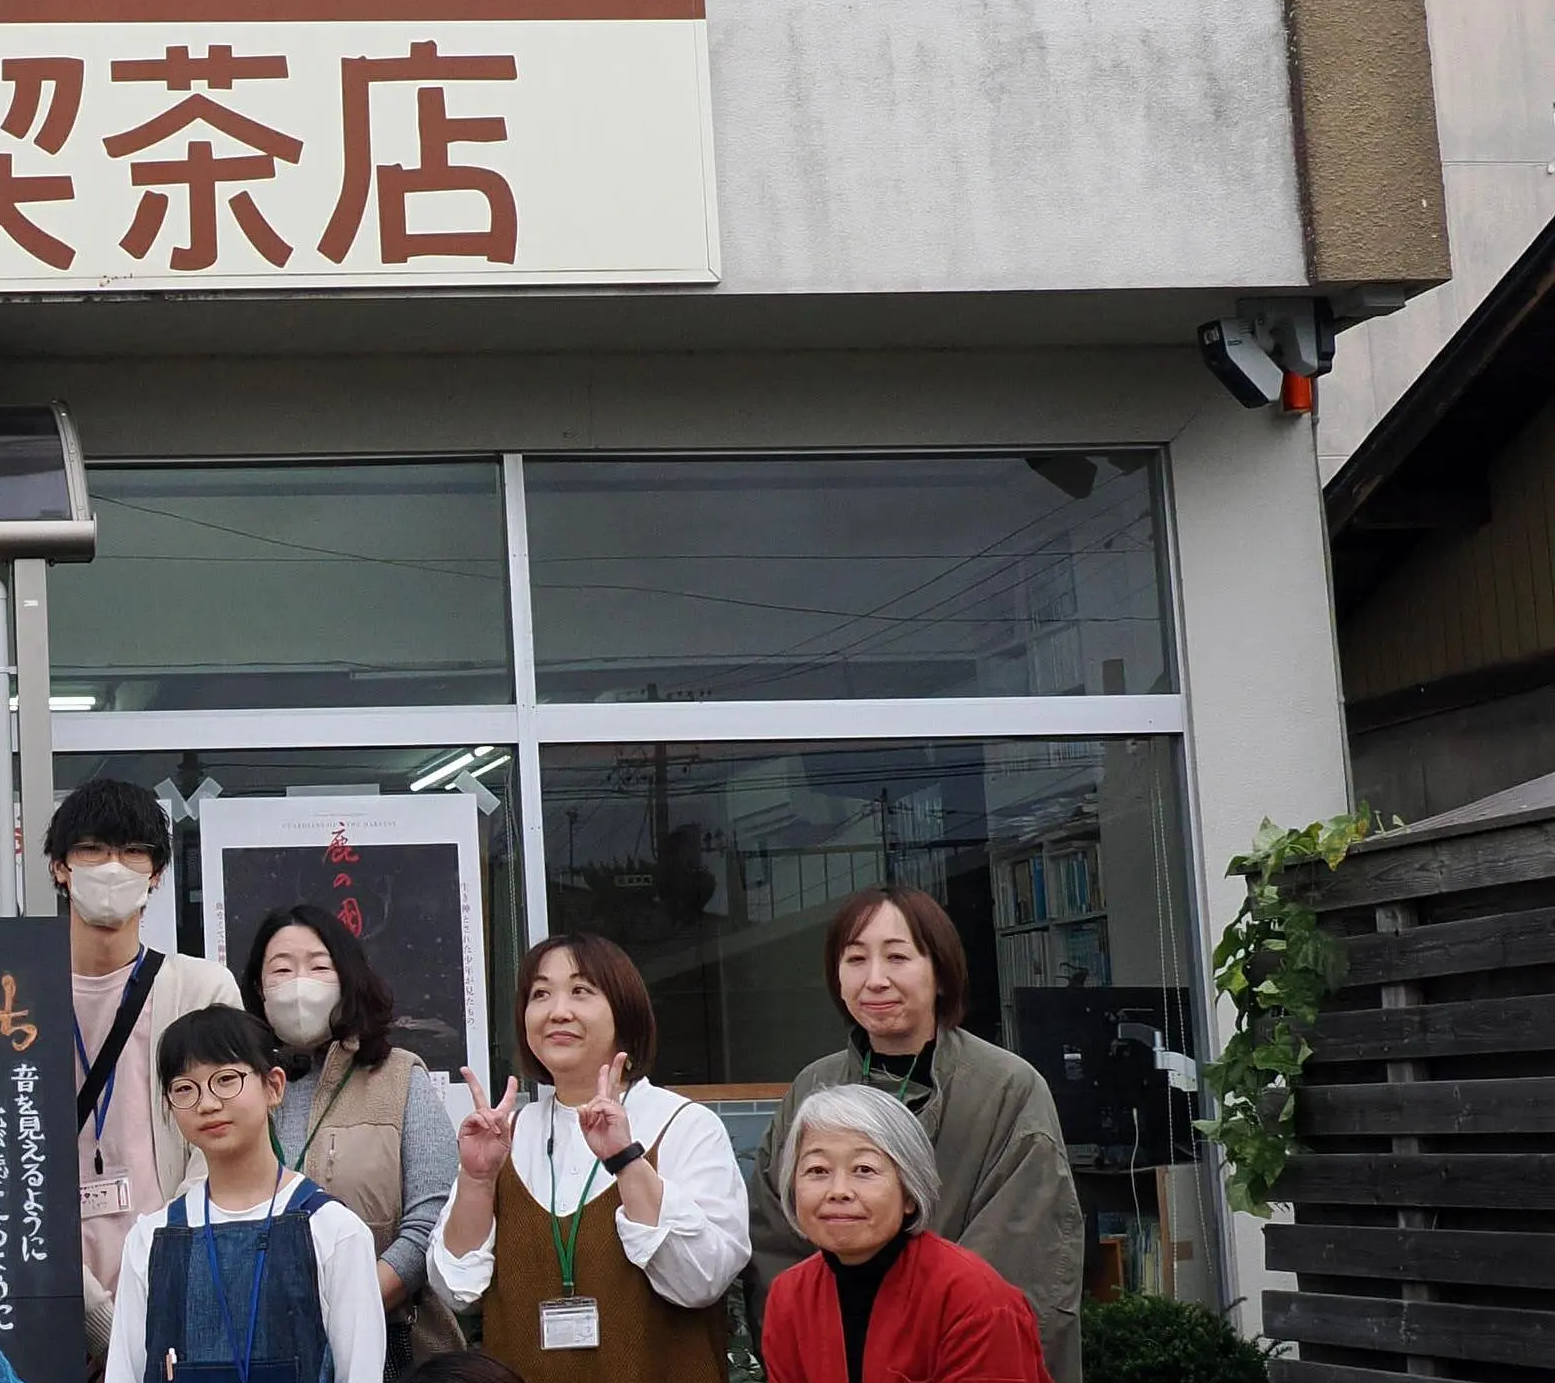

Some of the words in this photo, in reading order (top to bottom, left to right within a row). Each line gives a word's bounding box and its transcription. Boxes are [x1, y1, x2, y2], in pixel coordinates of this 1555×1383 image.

[10, 1063, 48, 1263] 音を見えるように
